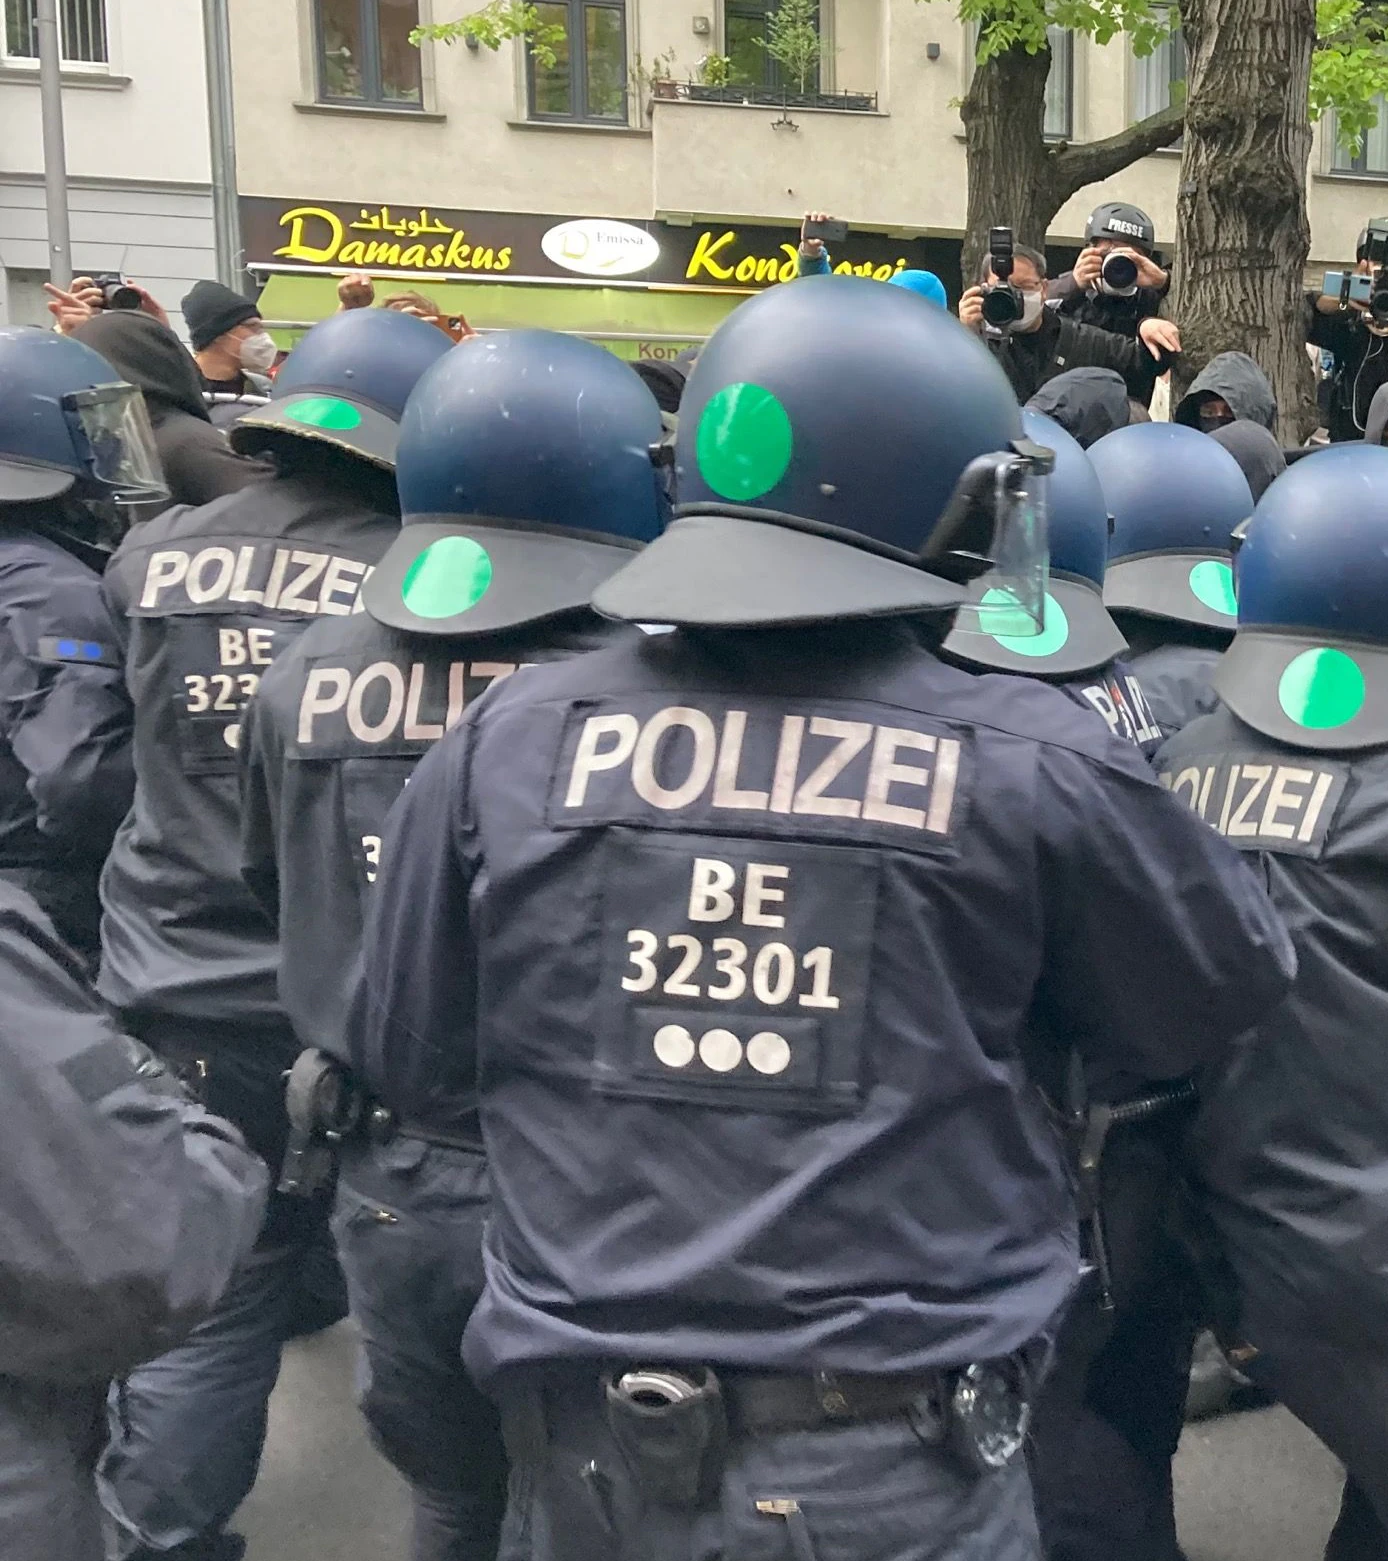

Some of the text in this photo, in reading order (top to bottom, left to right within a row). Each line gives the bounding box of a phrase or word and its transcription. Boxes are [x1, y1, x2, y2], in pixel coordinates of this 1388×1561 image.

[272, 206, 512, 271] Damaskus
[1107, 218, 1144, 238] PRESSE
[219, 628, 276, 666] BE
[184, 672, 260, 712] 323
[563, 706, 961, 835] POLIZEI
[1159, 764, 1333, 843] OLIZEI
[688, 858, 790, 929] BE
[621, 929, 840, 1010] 32301
